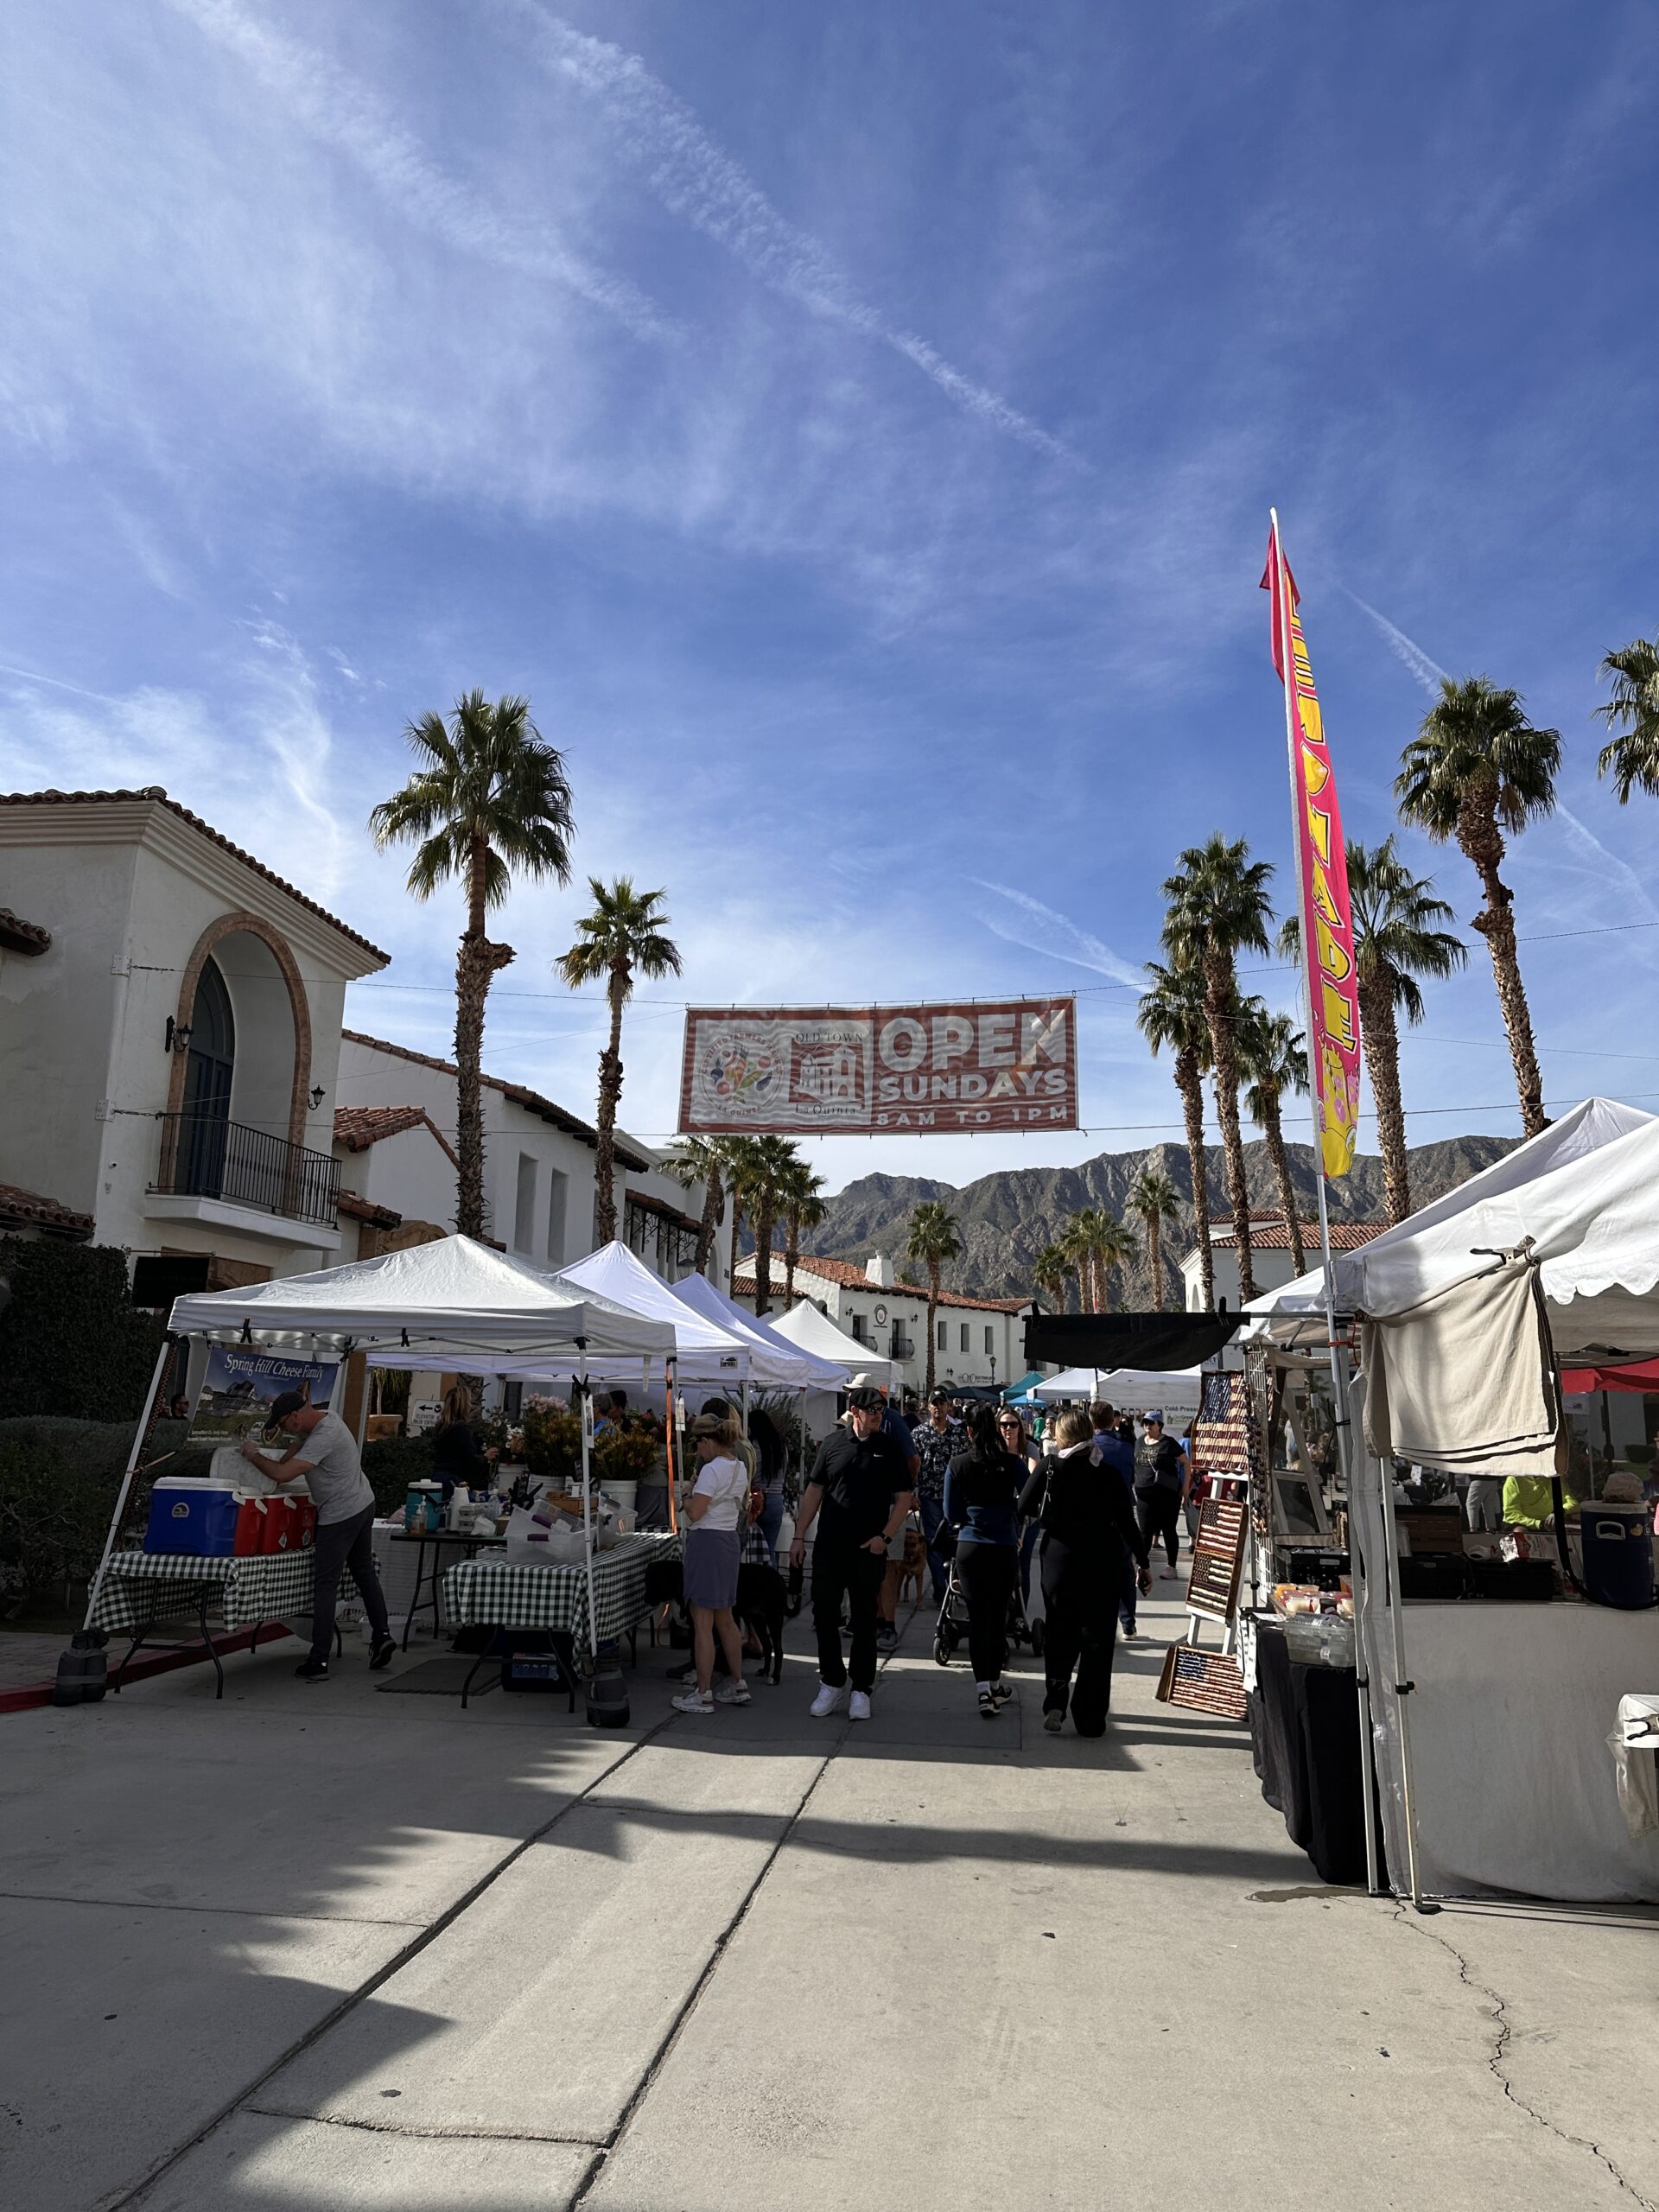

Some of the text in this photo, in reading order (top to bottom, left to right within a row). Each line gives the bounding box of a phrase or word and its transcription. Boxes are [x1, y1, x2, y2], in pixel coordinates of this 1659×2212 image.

[796, 1033, 862, 1042] OLD TOWN
[878, 1009, 1066, 1071] OPEN
[878, 1069, 1068, 1102] SUNDAYS
[796, 1103, 855, 1115] La Quinta
[876, 1106, 1067, 1126] 8AM TO 1PM
[225, 1354, 255, 1376] Spring
[254, 1358, 275, 1374] Hill
[274, 1361, 302, 1377] Cheese
[302, 1364, 324, 1382] Family
